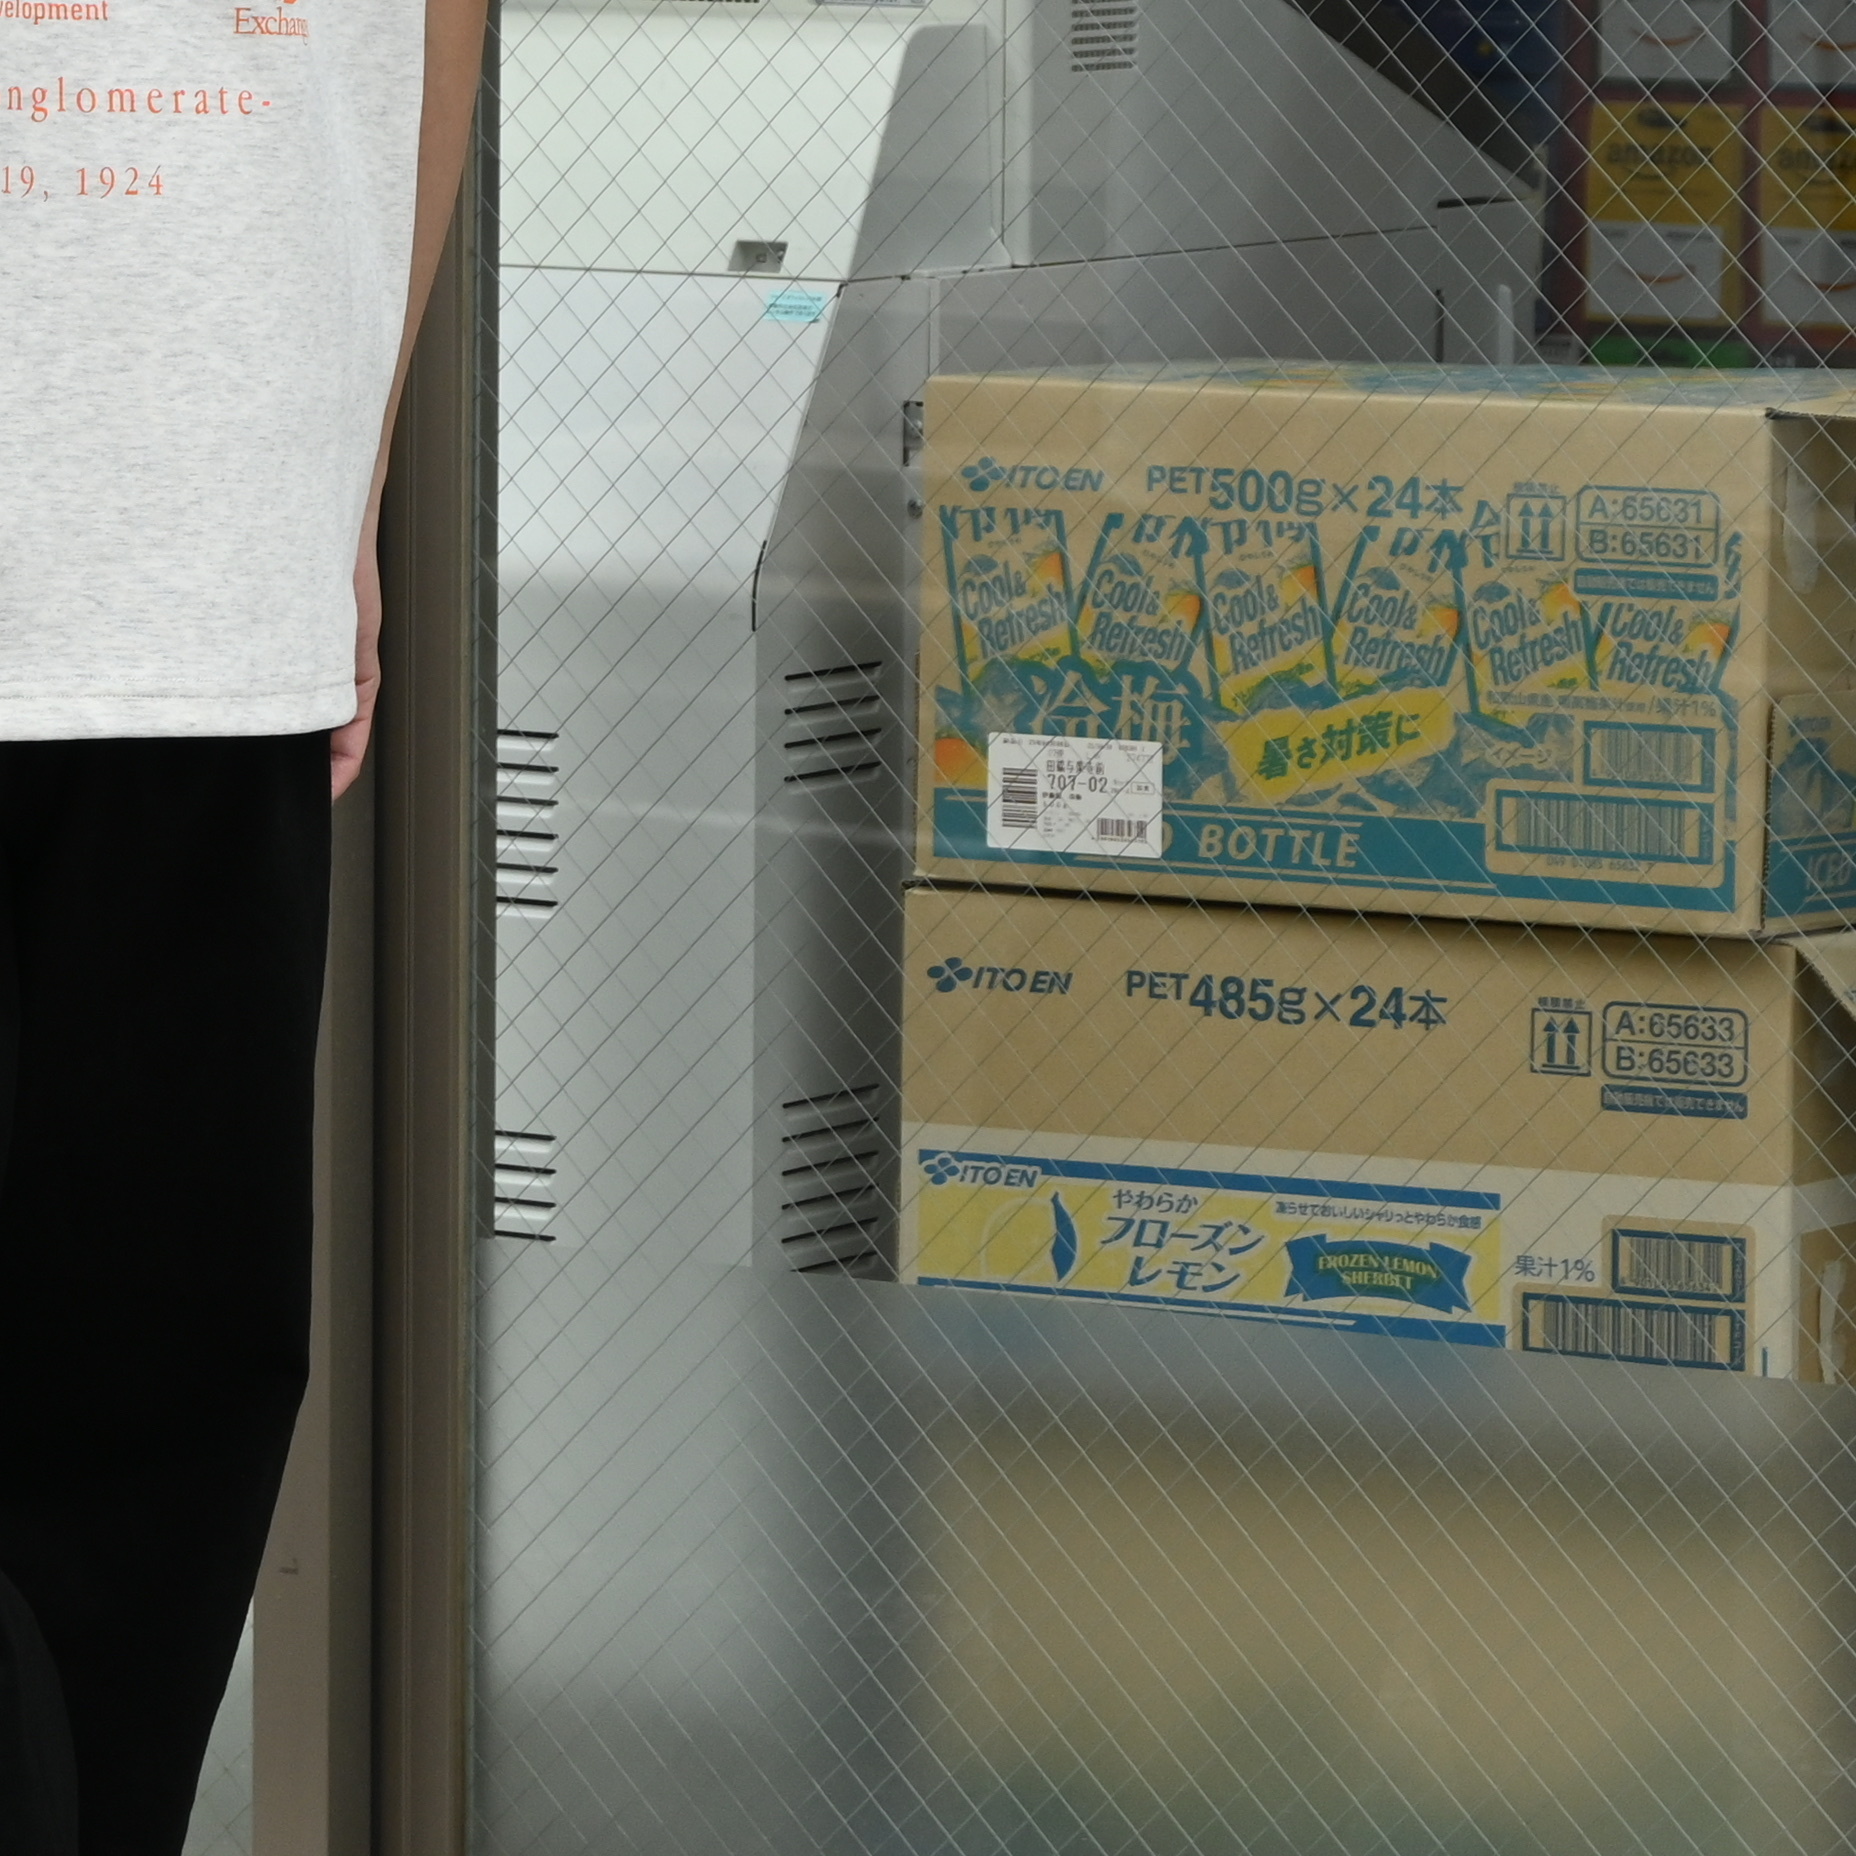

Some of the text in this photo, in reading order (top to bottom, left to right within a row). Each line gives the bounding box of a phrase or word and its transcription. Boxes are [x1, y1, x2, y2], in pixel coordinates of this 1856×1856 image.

[1, 166, 50, 202] 19,
[76, 166, 165, 197] 1924
[977, 584, 1066, 660] Refresh
[1088, 610, 1188, 661] Refresh
[1229, 598, 1321, 672] Refresh
[1344, 627, 1446, 679] Refresh
[1489, 609, 1582, 685] Refresh
[1607, 640, 1713, 692] Refresh
[1257, 710, 1422, 782] 暑さ対策に
[1047, 773, 1109, 794] 707-02
[1198, 825, 1360, 869] BOTTLE
[1615, 1010, 1735, 1042] A:65633
[1615, 1046, 1735, 1078] B:65633
[1112, 1187, 1199, 1215] やわらか
[1099, 1214, 1266, 1256] フローズン
[1127, 1254, 1242, 1294] レモン
[1318, 1252, 1438, 1278] FROZEN LEMON
[1341, 1271, 1415, 1291] SHERBET
